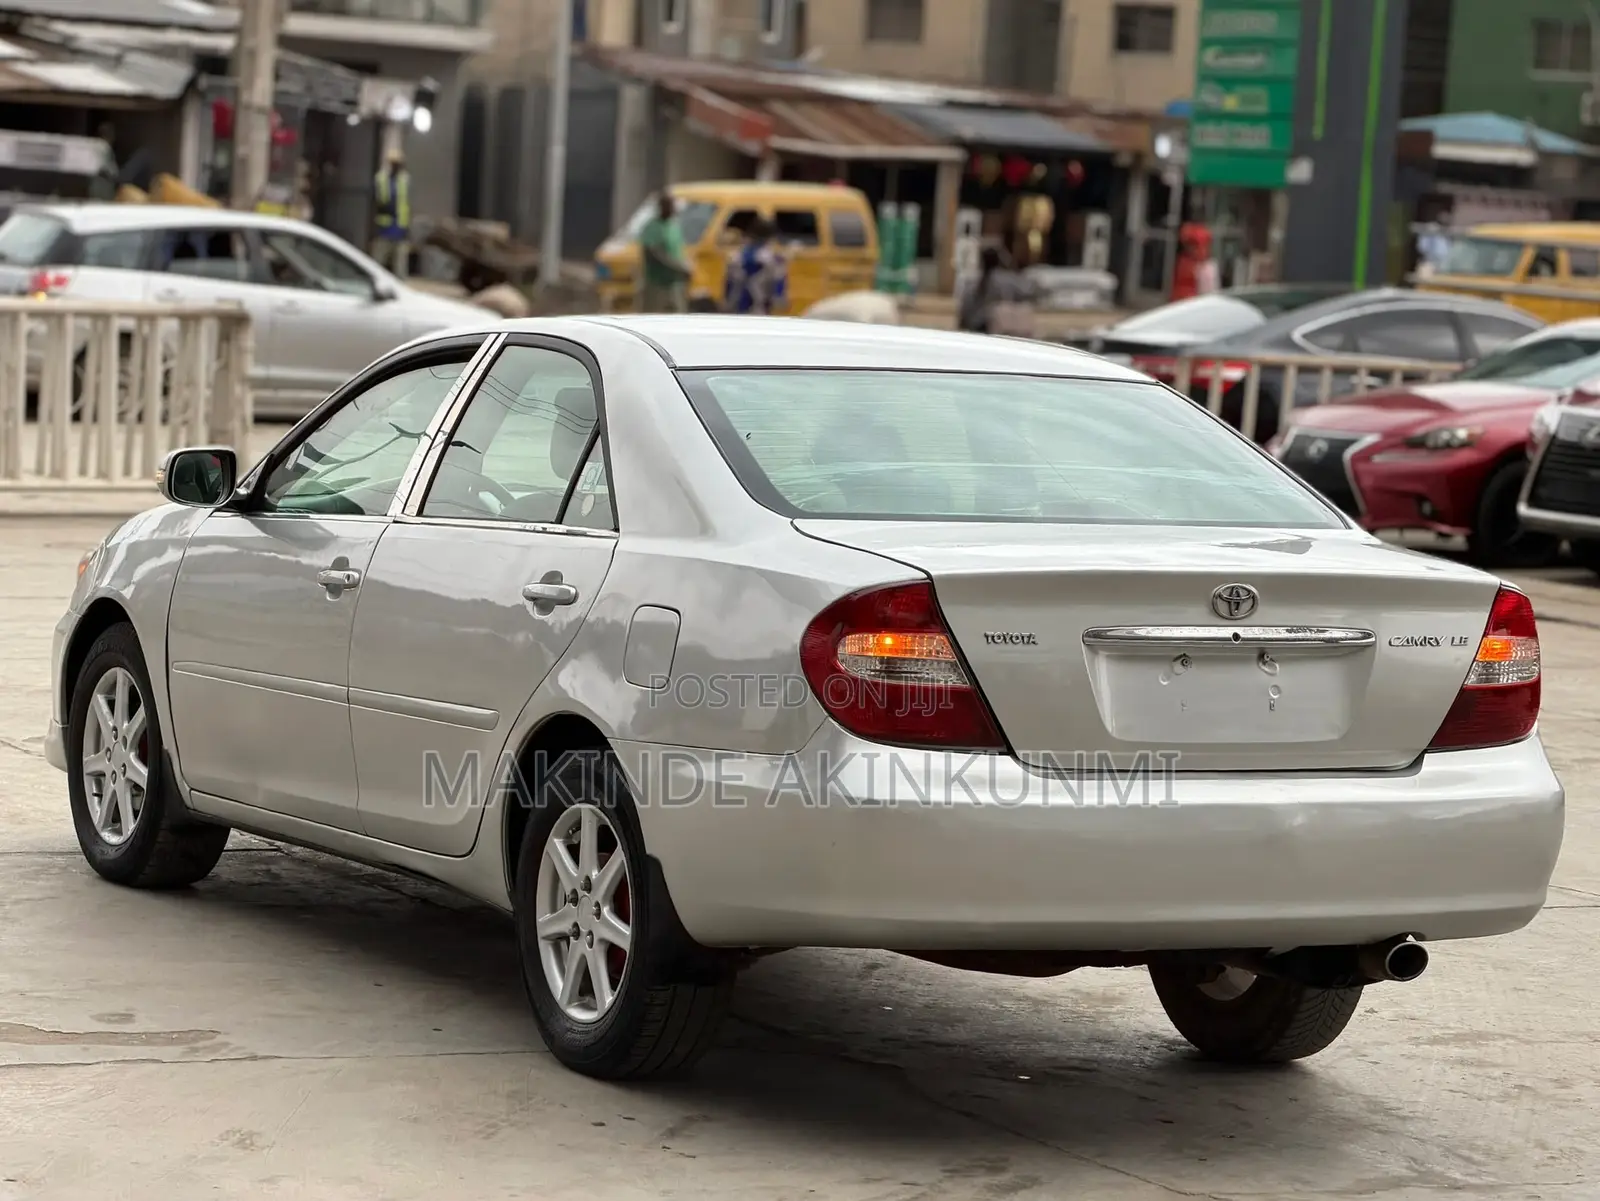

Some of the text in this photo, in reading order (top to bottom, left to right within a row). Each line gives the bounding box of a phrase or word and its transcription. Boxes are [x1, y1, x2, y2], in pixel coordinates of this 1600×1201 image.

[984, 632, 1038, 645] TOYOTA
[1388, 635, 1470, 648] CAMRY LE
